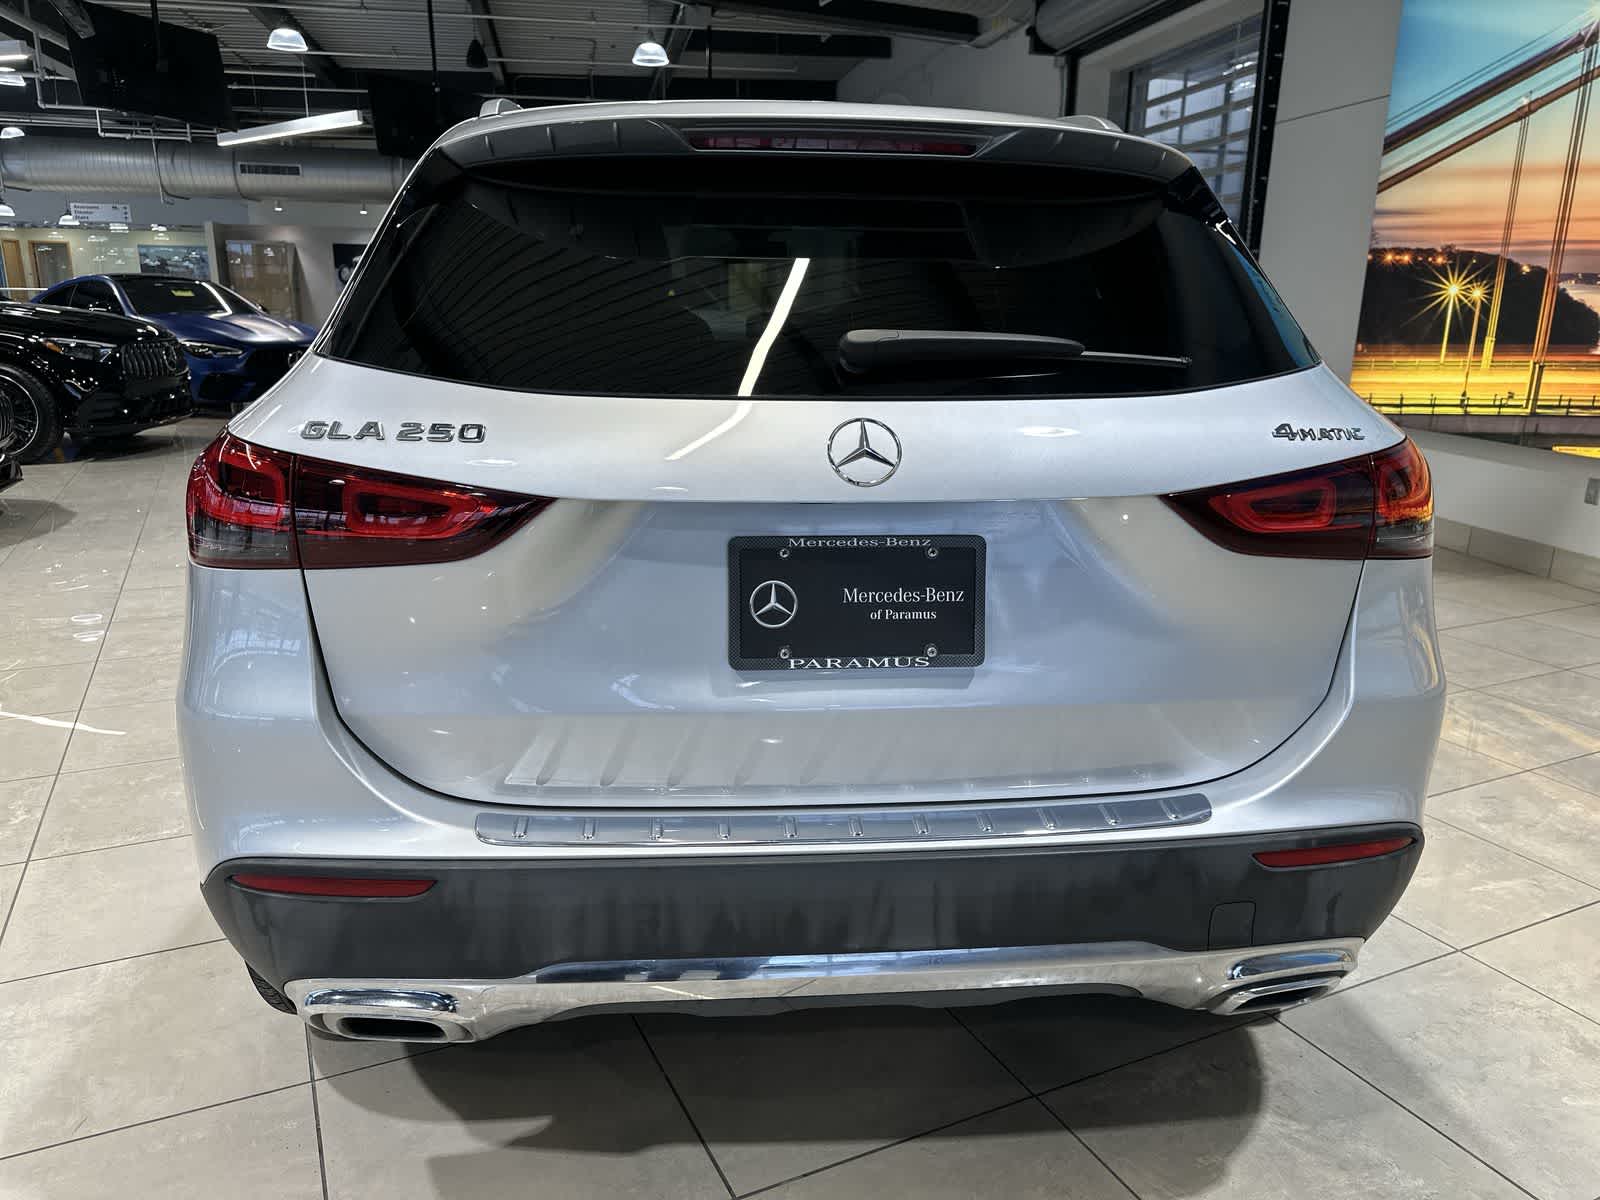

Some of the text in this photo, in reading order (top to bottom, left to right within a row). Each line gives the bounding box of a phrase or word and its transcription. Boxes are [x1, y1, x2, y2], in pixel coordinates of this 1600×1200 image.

[300, 421, 487, 443] GLA 250
[1272, 423, 1366, 441] 4MATIC
[788, 537, 932, 548] Mercedes-Benz
[842, 587, 965, 603] Mercedes-Benz
[870, 609, 937, 620] of Paramus
[789, 656, 930, 669] PARAMUS
